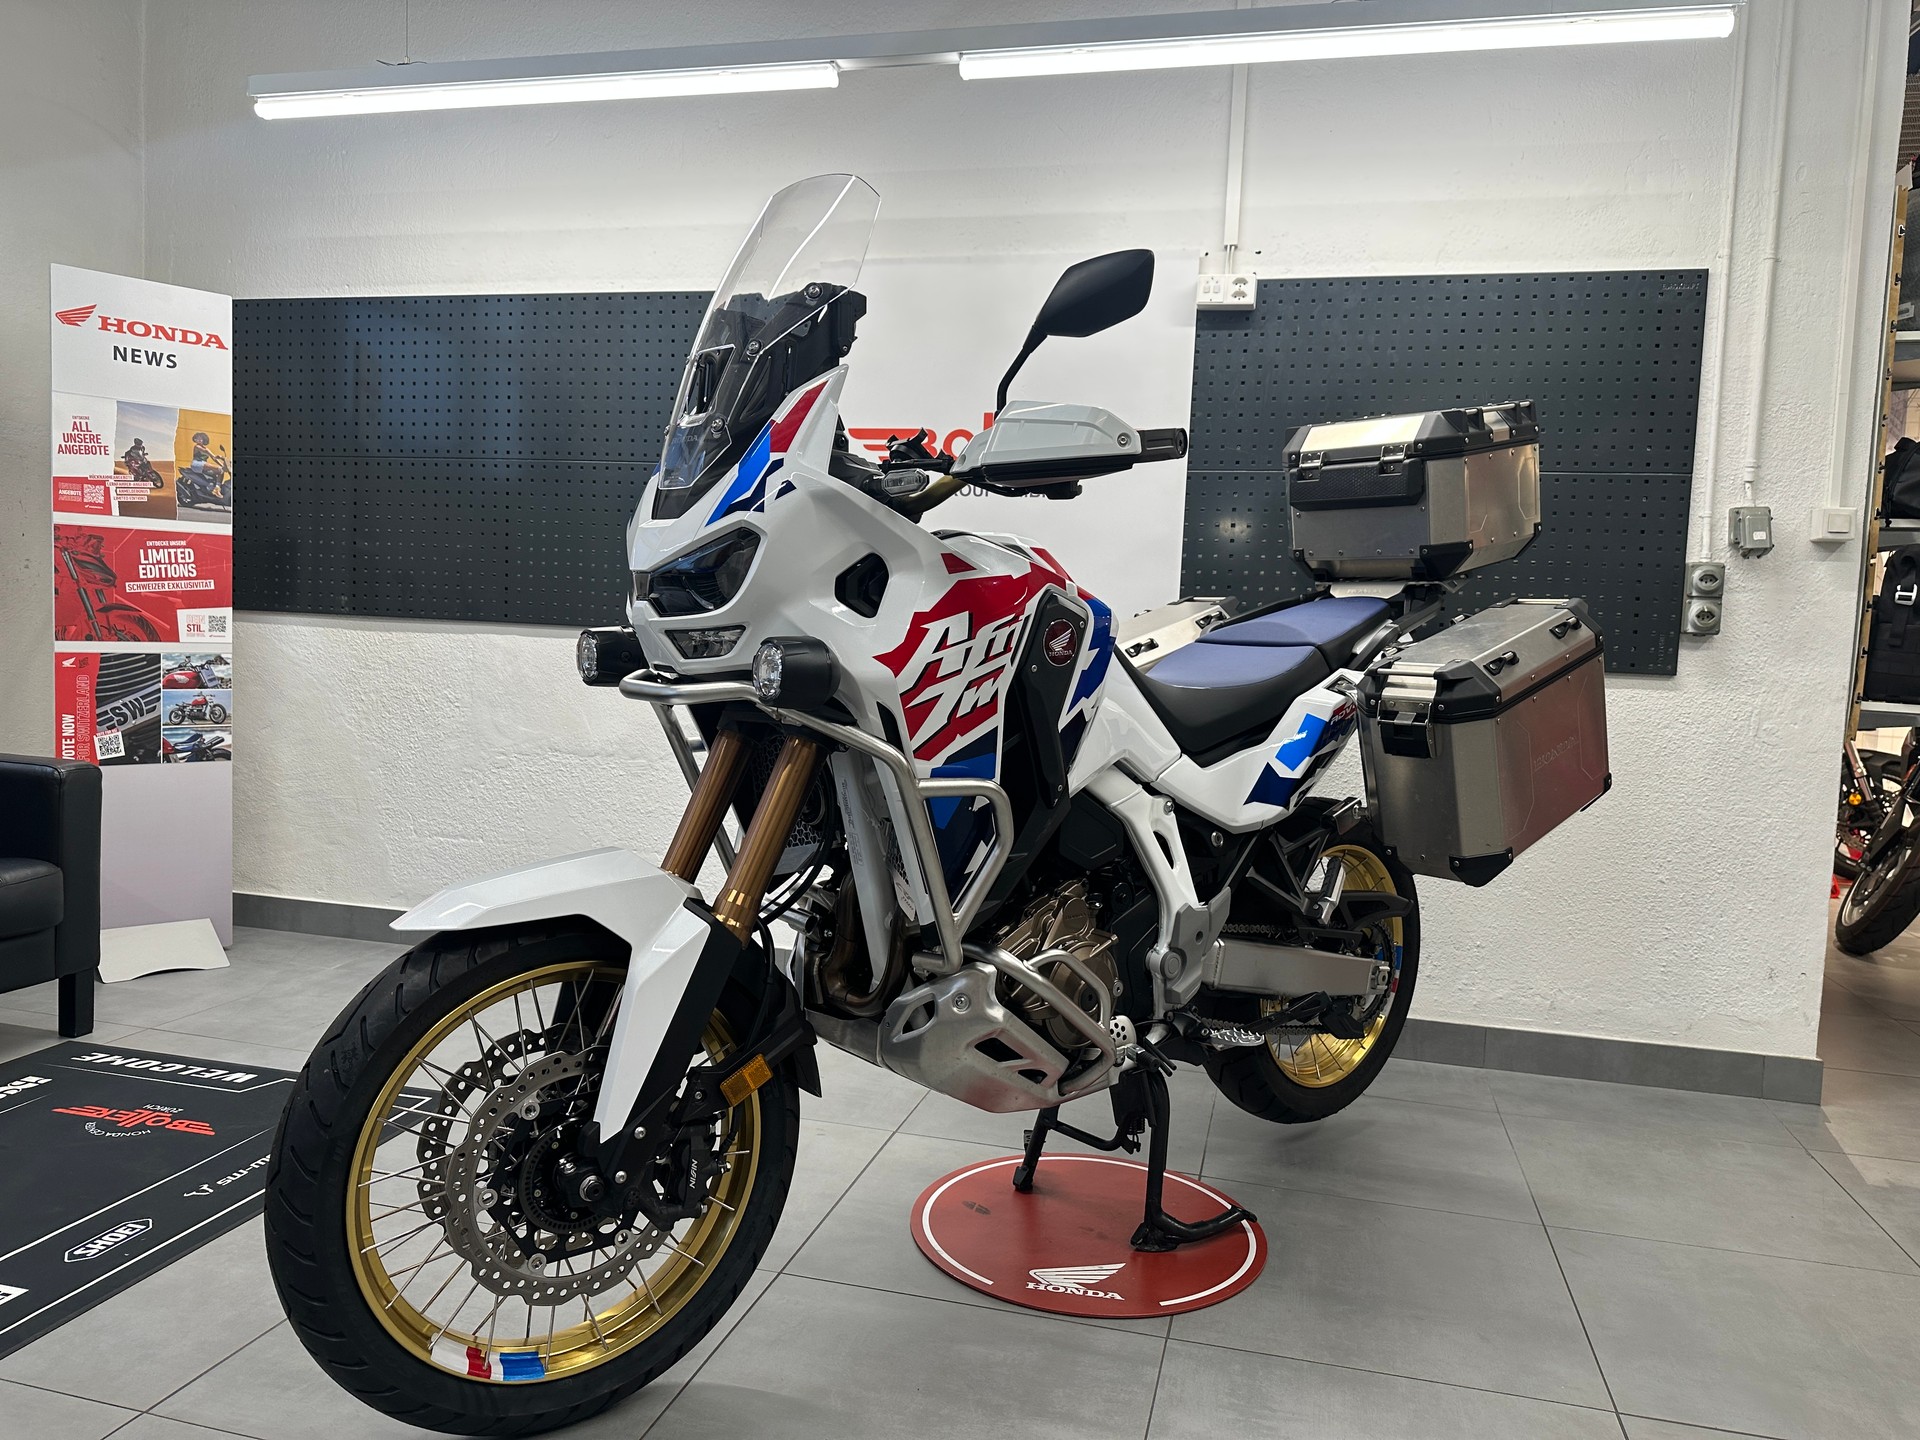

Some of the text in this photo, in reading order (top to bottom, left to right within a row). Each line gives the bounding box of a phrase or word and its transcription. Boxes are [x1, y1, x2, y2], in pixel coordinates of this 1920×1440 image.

[98, 315, 228, 350] HONDA
[113, 345, 178, 369] NEWS
[72, 421, 92, 433] ALL
[62, 433, 102, 444] UNSERE
[57, 444, 110, 456] ANGEBOTE
[139, 548, 195, 564] LIMITED
[138, 564, 197, 579] EDITIONS
[127, 582, 166, 592] SCHWEIZER
[186, 624, 206, 633] STIL.
[77, 674, 90, 743] SWITZERLAND
[109, 697, 146, 728] SW
[62, 714, 75, 736] NOW
[70, 1052, 259, 1084] WELCOME
[105, 1129, 152, 1138] HONDA
[74, 1223, 147, 1257] SHOEI
[1025, 1281, 1125, 1301] HONDA
